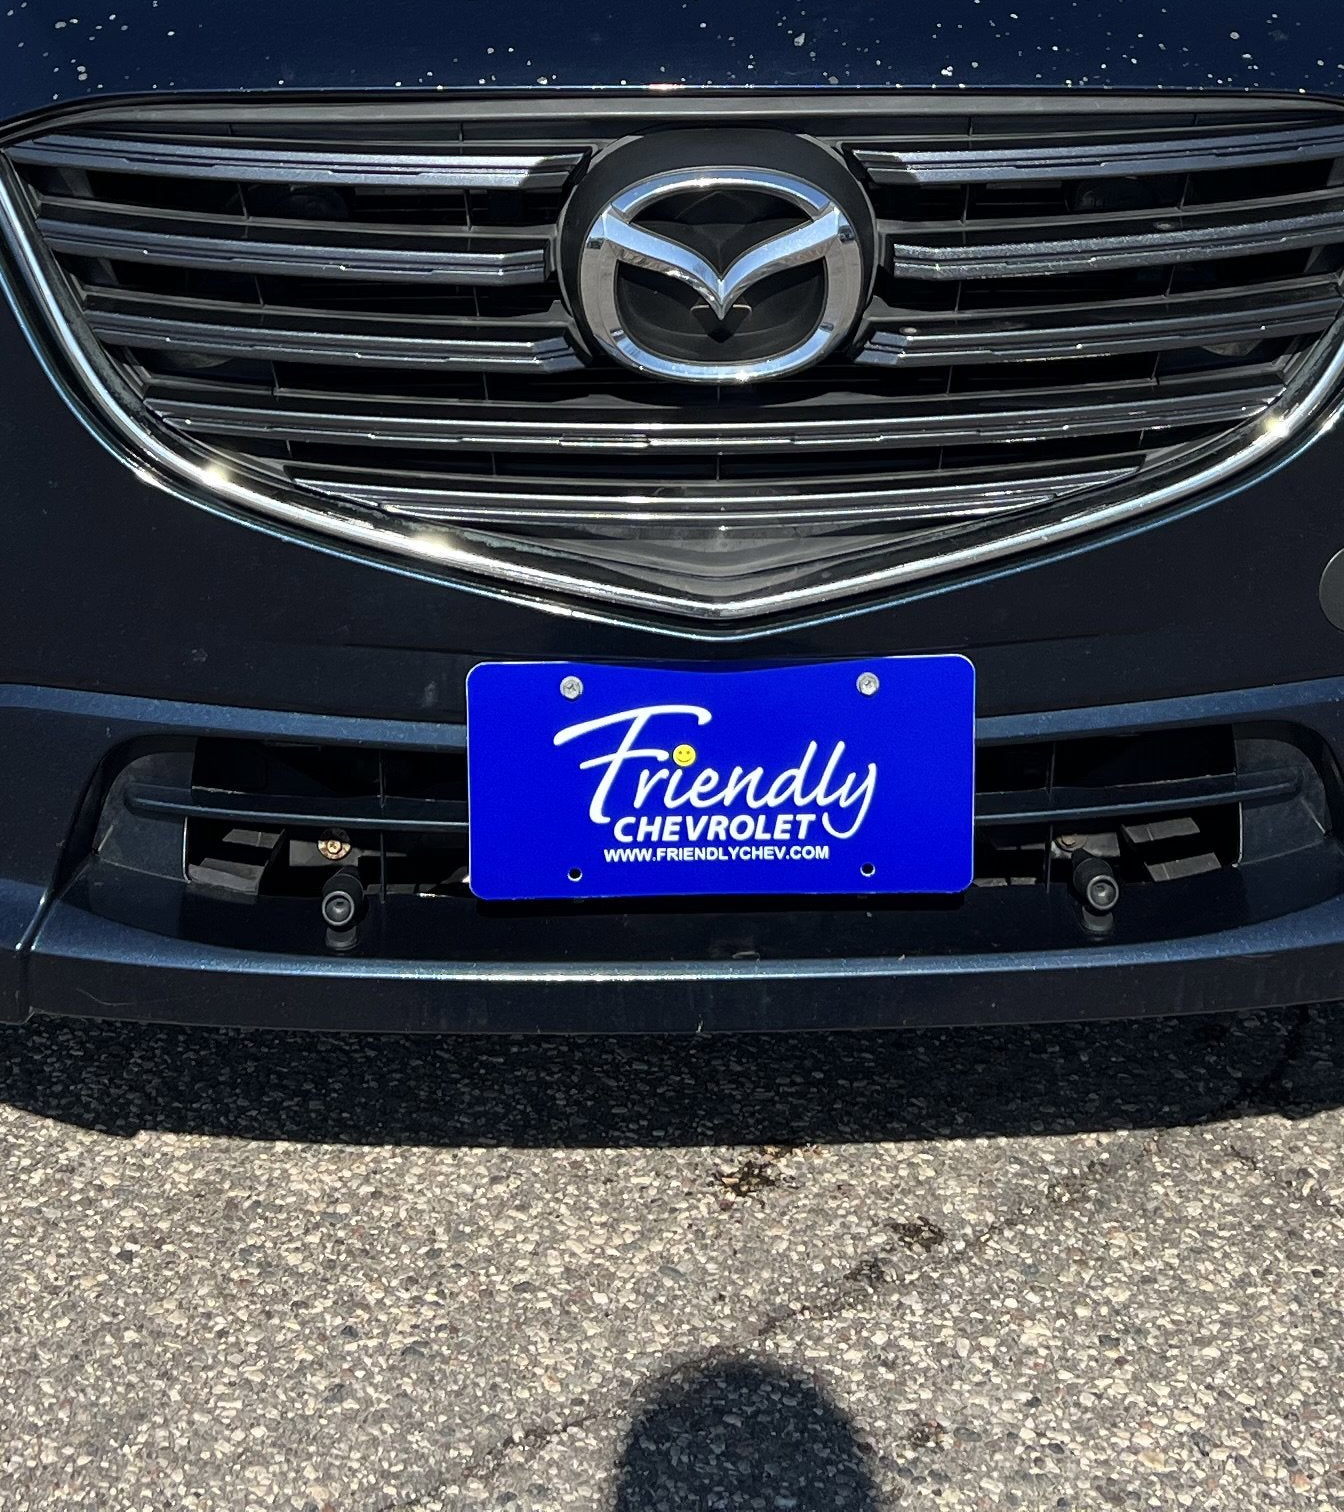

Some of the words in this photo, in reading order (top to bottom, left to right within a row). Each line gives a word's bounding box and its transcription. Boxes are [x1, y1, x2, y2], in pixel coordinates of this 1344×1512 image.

[553, 705, 877, 839] Friendly
[613, 814, 816, 842] CHEVROLET
[604, 846, 830, 862] WWW.FRIENDLYCHEV.COM
